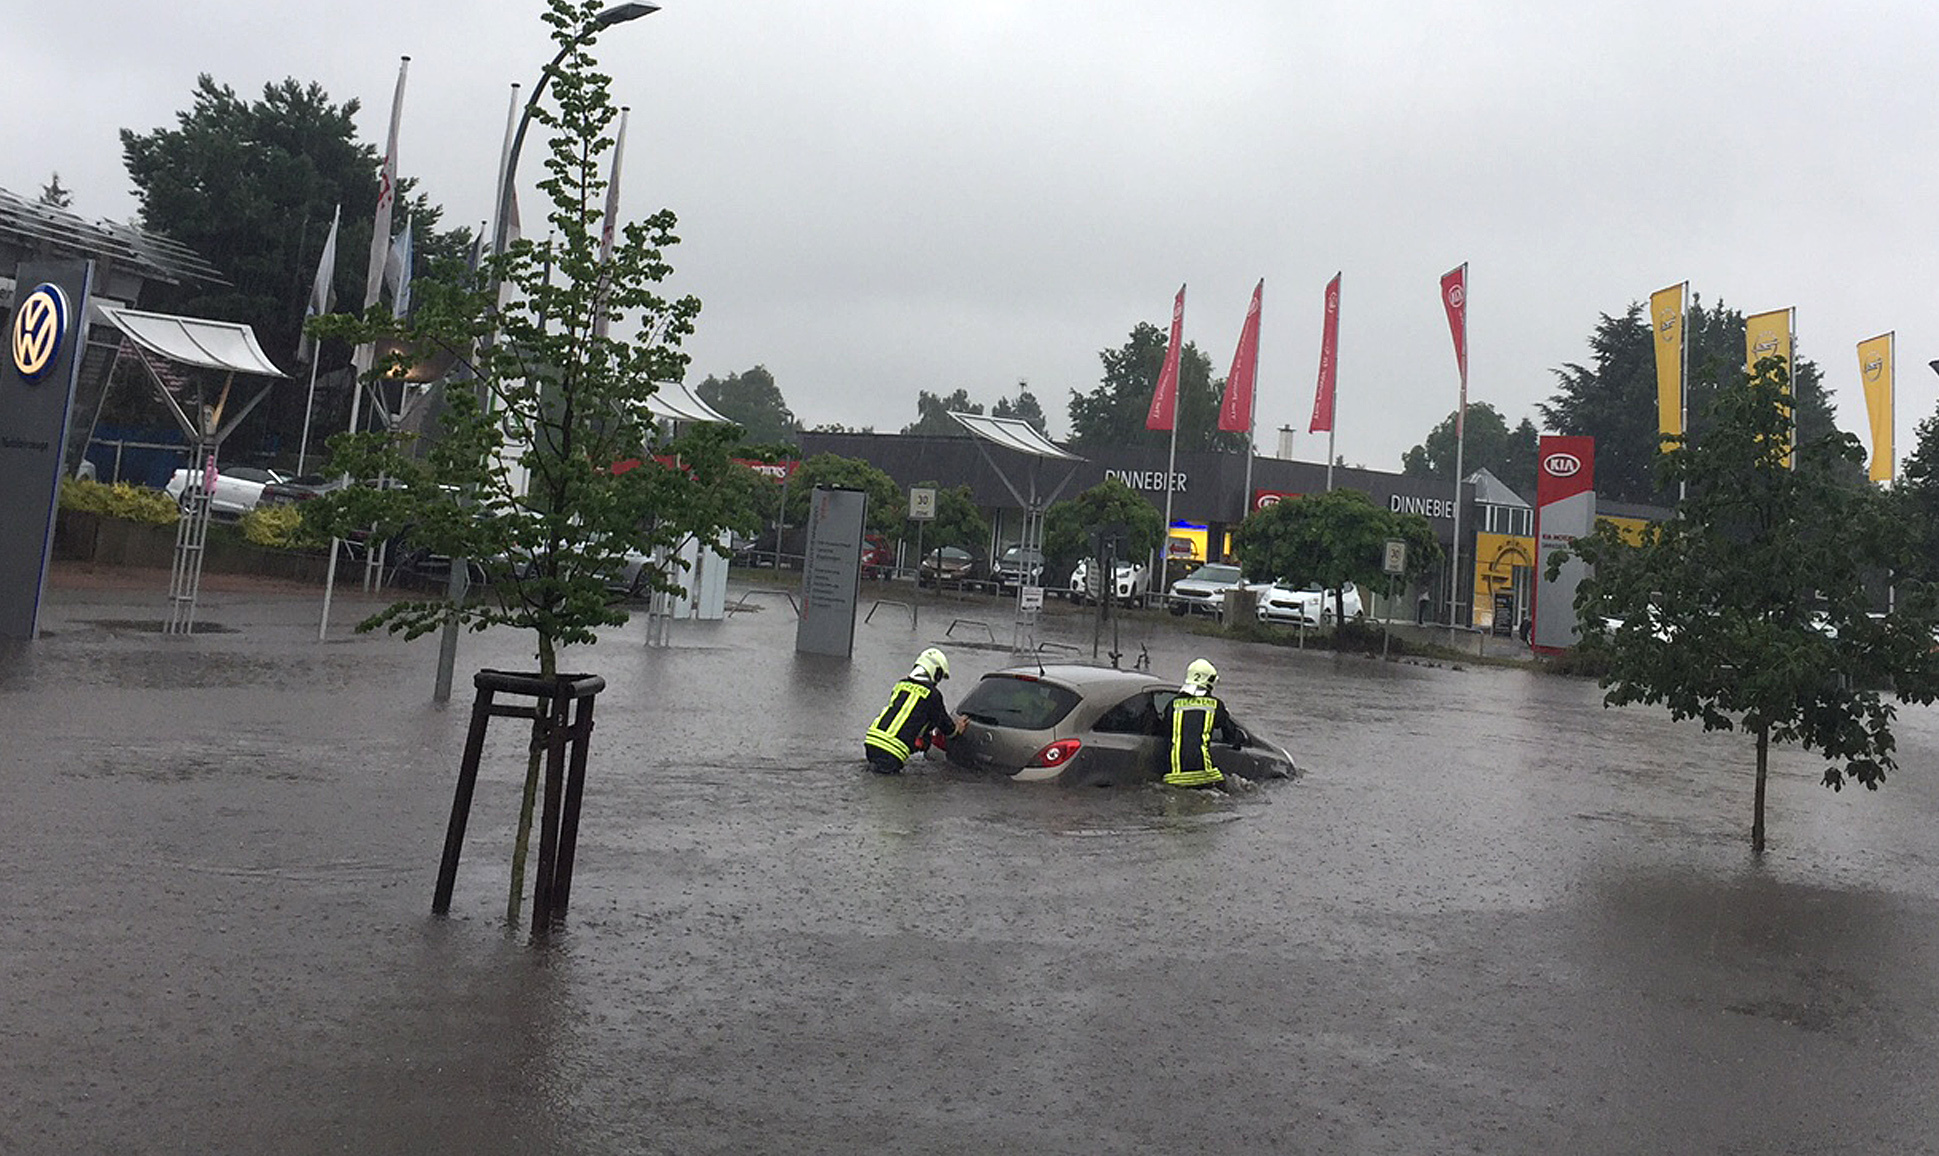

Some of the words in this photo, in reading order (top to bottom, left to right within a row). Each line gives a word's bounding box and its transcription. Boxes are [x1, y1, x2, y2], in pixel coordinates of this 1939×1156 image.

[1549, 458, 1575, 471] KIA
[1105, 469, 1187, 491] DINNEBIER
[918, 494, 929, 505] 30
[1194, 673, 1201, 682] 2
